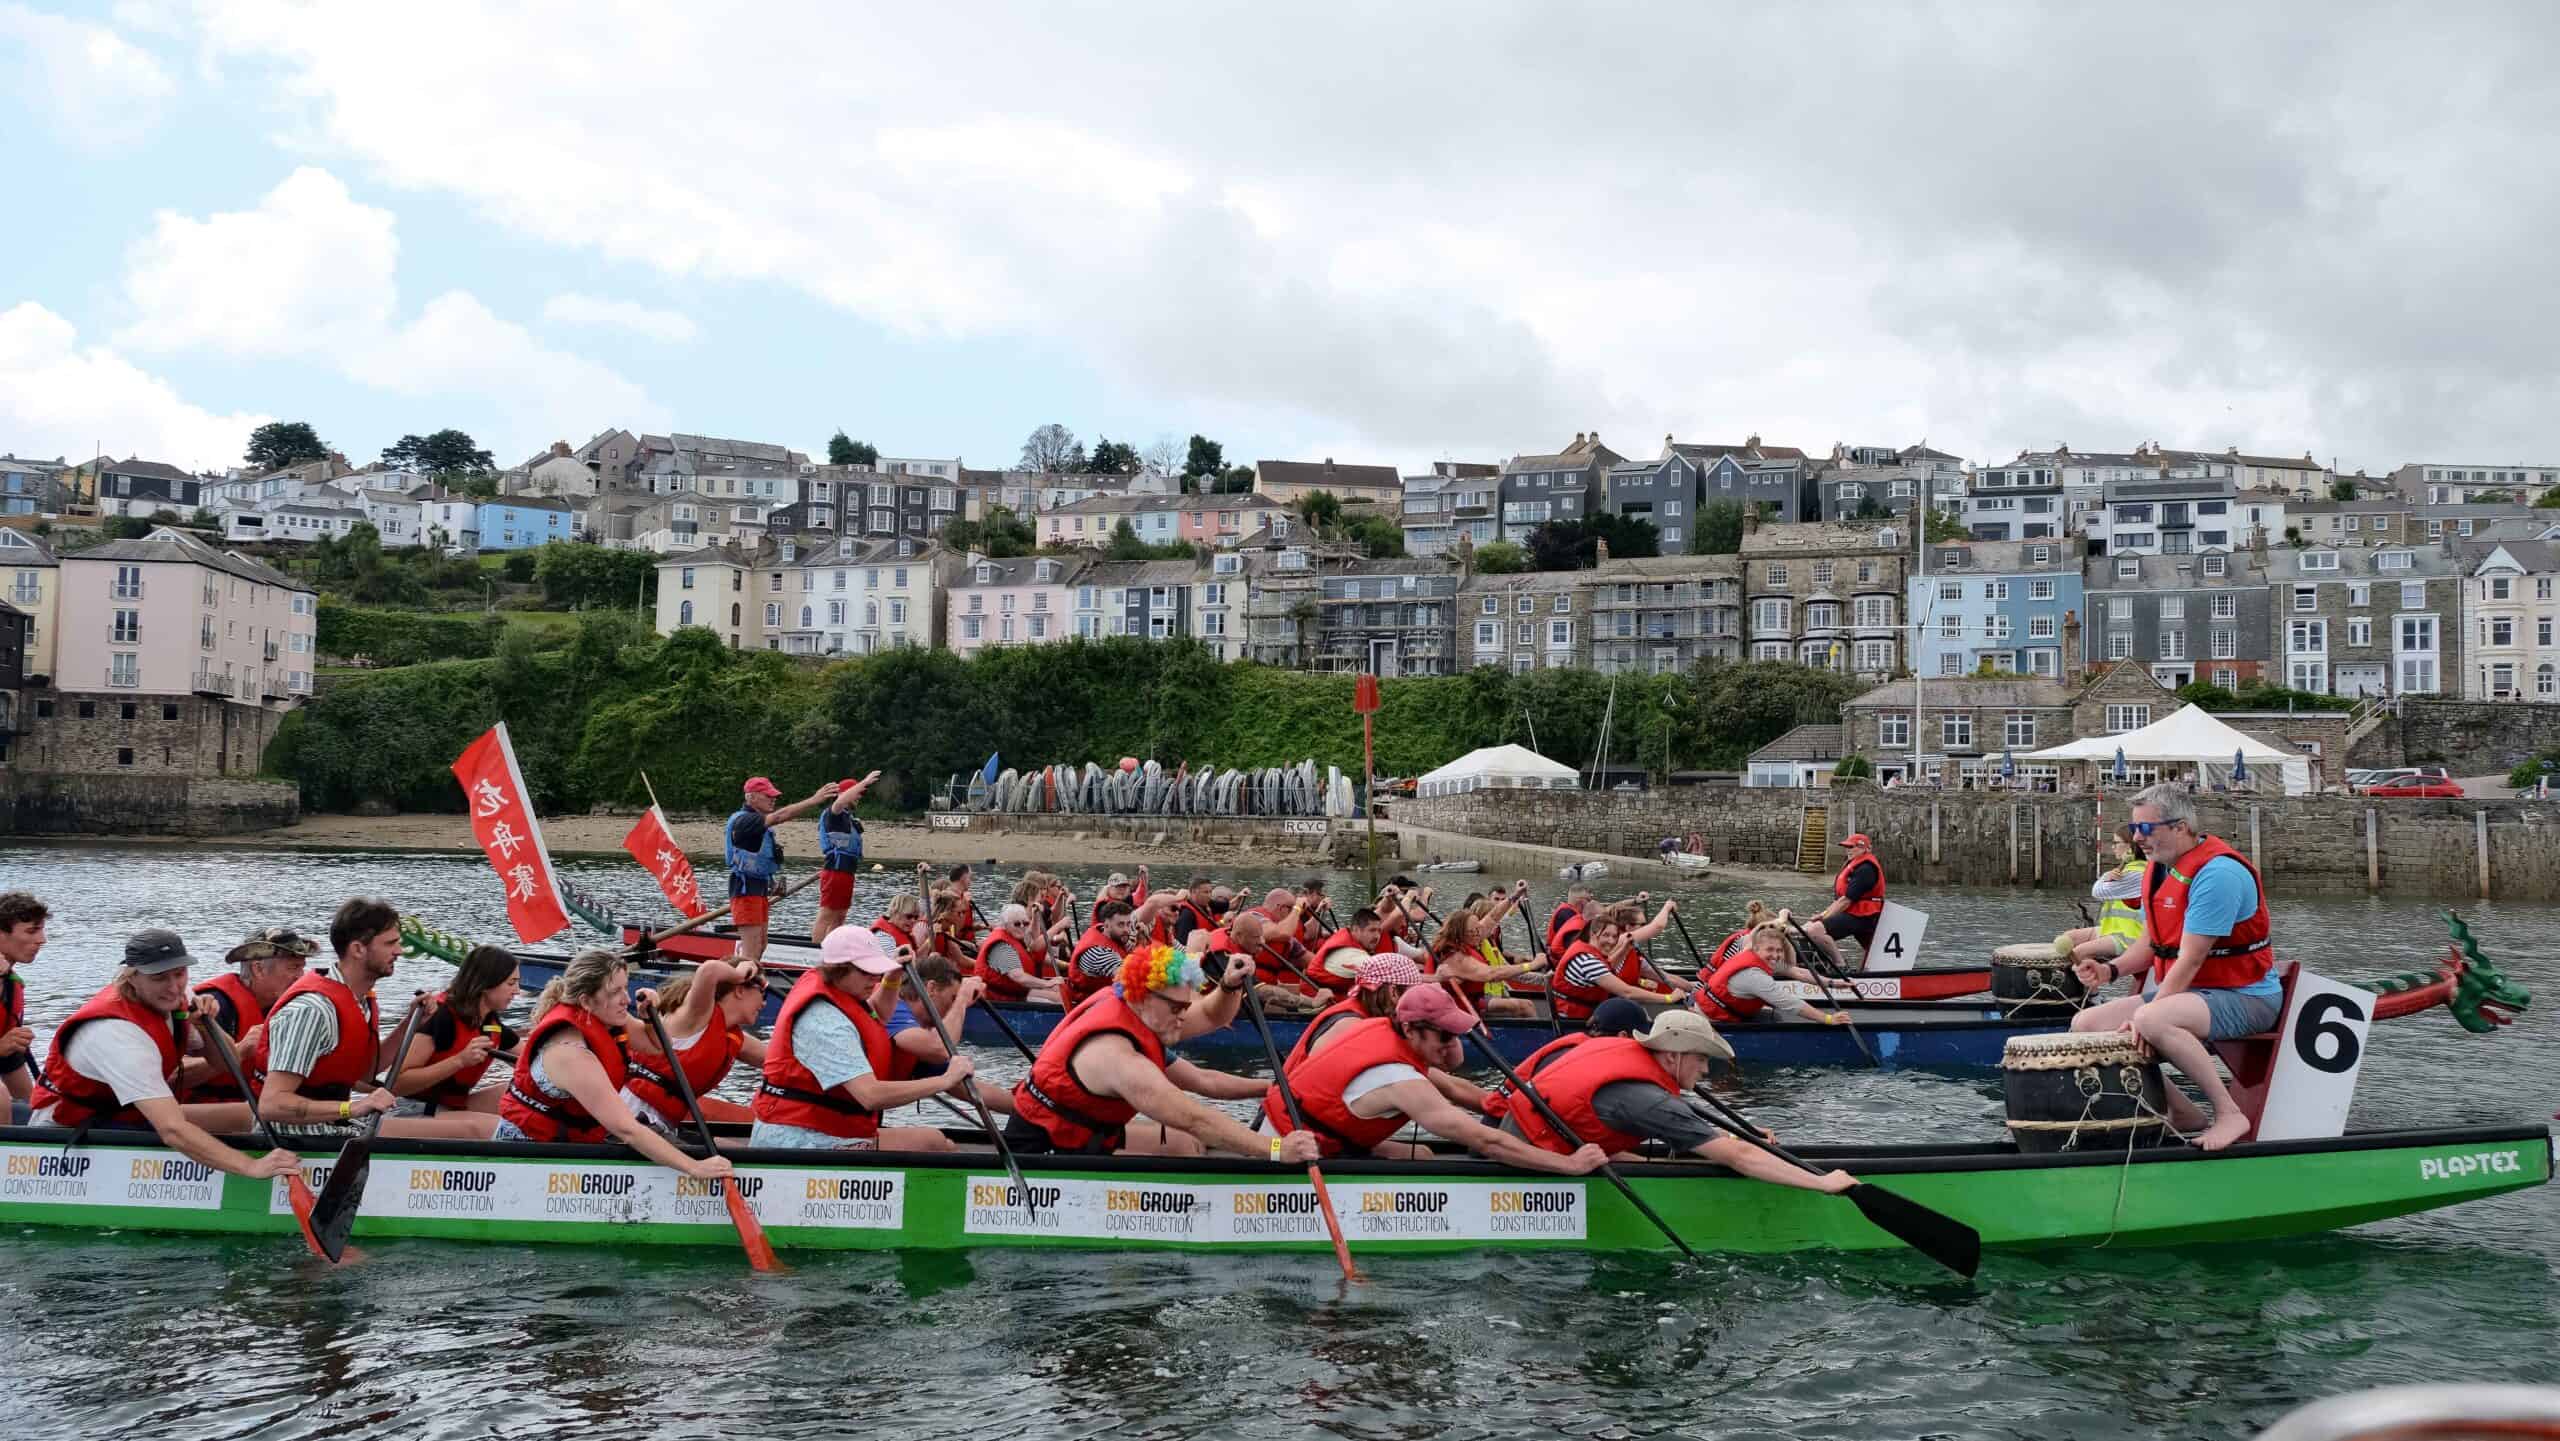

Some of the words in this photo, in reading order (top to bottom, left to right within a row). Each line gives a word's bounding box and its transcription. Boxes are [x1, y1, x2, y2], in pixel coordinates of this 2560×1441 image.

[934, 816, 966, 826] RCYC
[1286, 821, 1324, 831] RCYC
[1883, 931, 1904, 959] 4
[2294, 993, 2365, 1074] 6
[2419, 1150, 2521, 1180] PLASTEX
[4, 1178, 88, 1197] CONSTRUCTION
[410, 1168, 496, 1192] BSNGROUP
[548, 1172, 634, 1195] BSNGROUP
[806, 1178, 893, 1201] BSNGROUP
[128, 1181, 212, 1201] CONSTRUCTION
[408, 1192, 494, 1212] CONSTRUCTION
[546, 1195, 633, 1216] CONSTRUCTION
[674, 1197, 762, 1217] CONSTRUON
[804, 1200, 892, 1220] CONSTRUCTION
[1107, 1189, 1194, 1214] BSNGROUP
[1233, 1192, 1320, 1214] BSNGROUP
[1361, 1191, 1449, 1214] BSNGROUP
[1490, 1190, 1576, 1213] BSNGROUP
[1105, 1214, 1193, 1232] CONSTRUCTION
[1232, 1215, 1321, 1233] CONSTRUCTION
[1361, 1214, 1450, 1232] CONSTRUCTION
[1490, 1214, 1577, 1233] CONSTRUCTION
